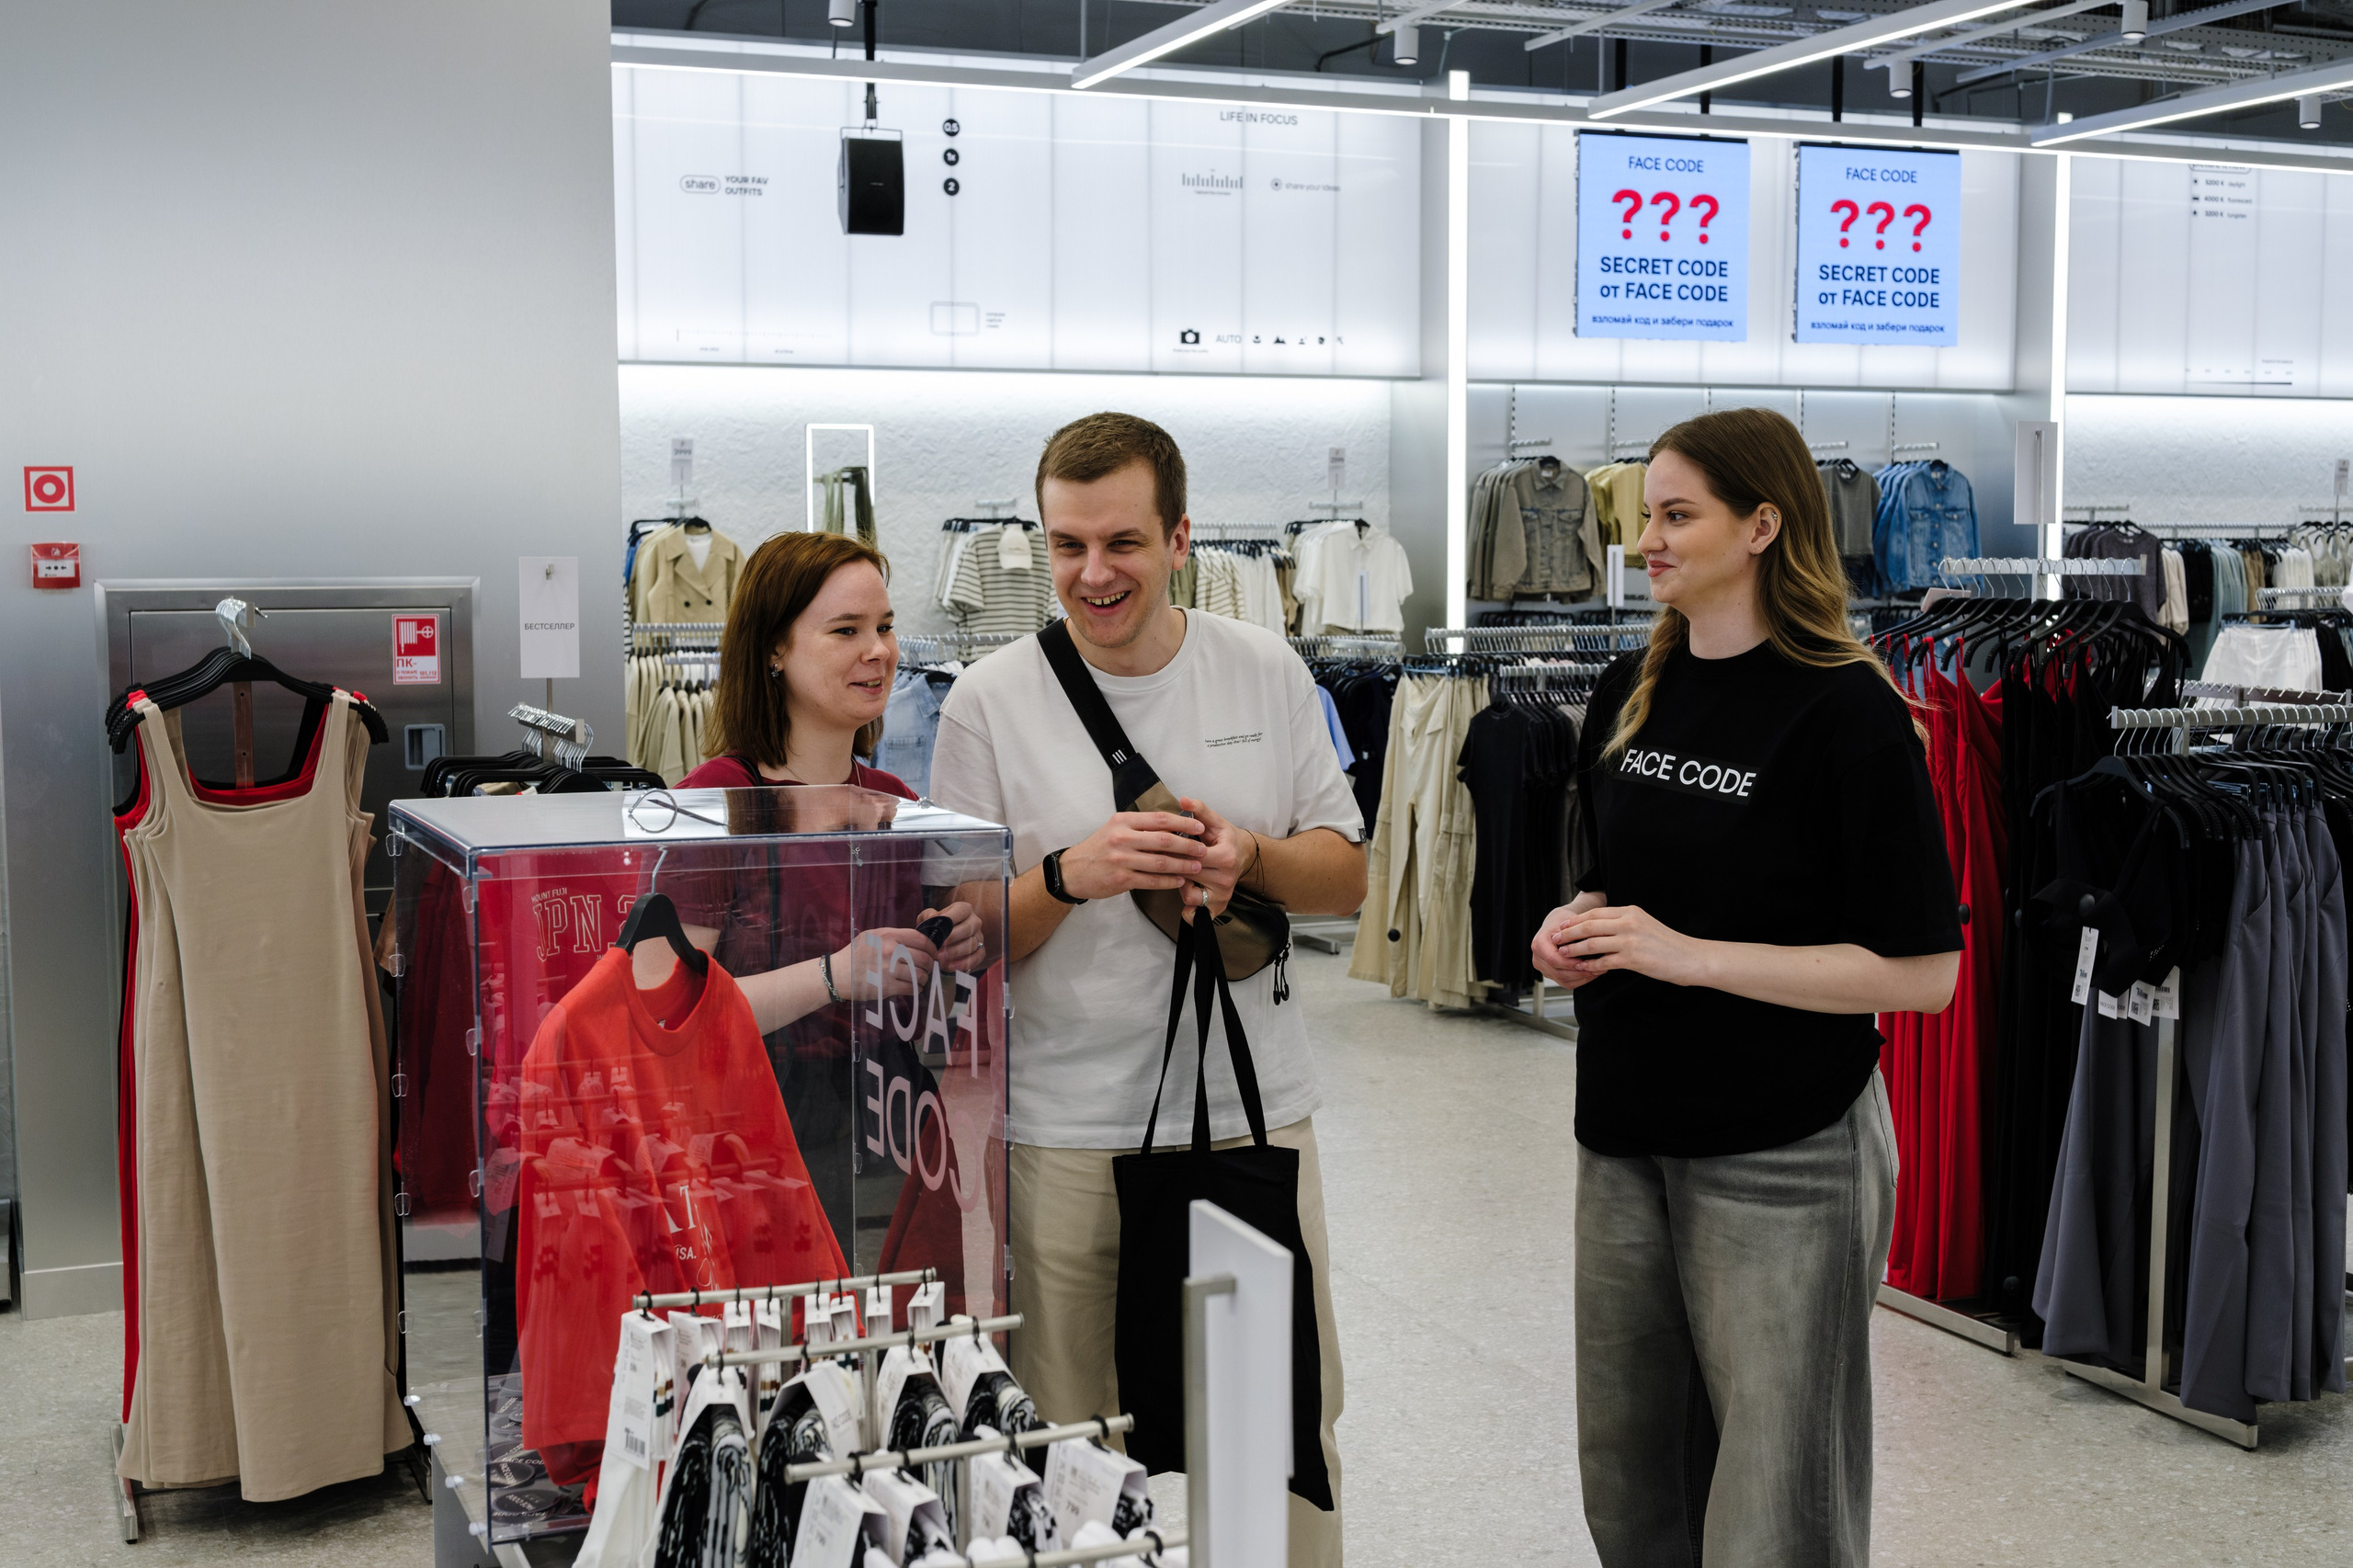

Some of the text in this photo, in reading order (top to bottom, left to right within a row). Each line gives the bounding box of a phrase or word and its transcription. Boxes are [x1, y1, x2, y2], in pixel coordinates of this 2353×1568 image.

[1220, 111, 1298, 125] LIFE IN FOCUS
[1628, 155, 1704, 173] FACE CODE
[685, 176, 768, 189] share YOUR FAV
[1846, 167, 1917, 183] FACE CODE
[725, 187, 763, 197] OUTFITS
[948, 181, 956, 192] 2
[1612, 188, 1720, 244] ???
[1830, 199, 1932, 253] ???
[1600, 256, 1728, 278] SECRET CODE
[1819, 265, 1939, 284] SECRET CODE
[1600, 282, 1728, 301] от FACE CODE
[1819, 290, 1939, 308] от FACE CODE
[1592, 313, 1631, 324] взломай
[1634, 318, 1651, 326] код
[1661, 315, 1693, 327] забери
[1696, 319, 1733, 328] подарок
[1811, 320, 1848, 330] взломай
[1851, 324, 1866, 332] код
[1876, 321, 1906, 333] забери
[1909, 324, 1945, 333] подарок
[1216, 335, 1242, 344] AUTO
[525, 622, 574, 631] БЕСТСЕЛЛЕР
[1620, 748, 1756, 797] FACE CODE
[531, 887, 568, 903] MOUNT FUJI
[532, 894, 602, 962] JPN
